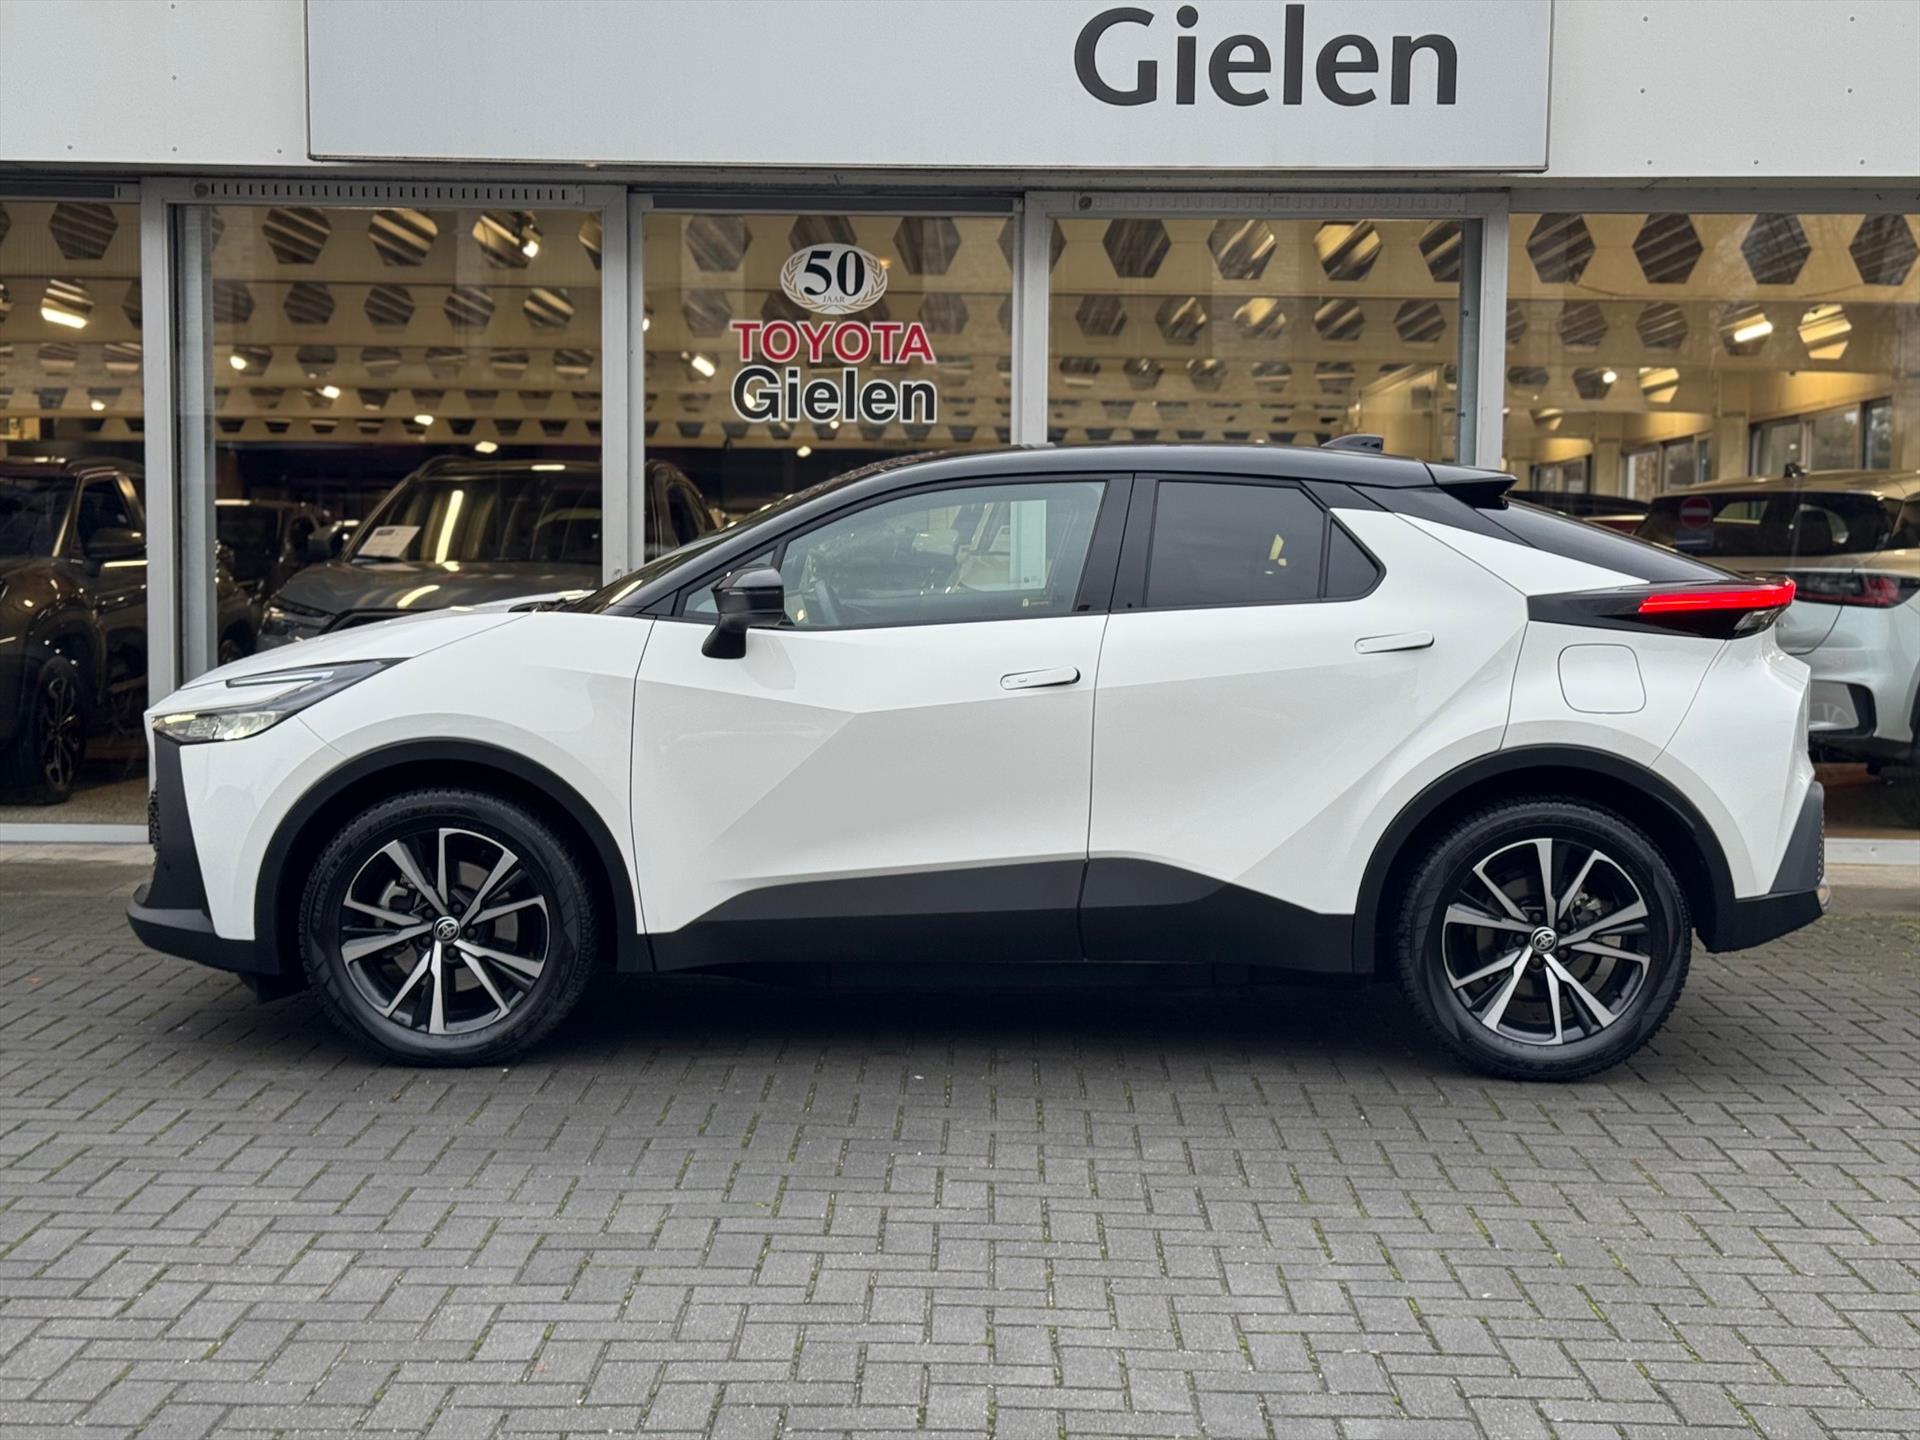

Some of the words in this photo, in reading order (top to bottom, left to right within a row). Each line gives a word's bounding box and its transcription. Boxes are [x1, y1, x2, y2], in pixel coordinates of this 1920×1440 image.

[1073, 4, 1458, 107] Gielen
[803, 250, 865, 296] 50
[823, 295, 845, 303] JAAR
[730, 321, 936, 364] TOYOTA
[732, 365, 938, 424] Gielen
